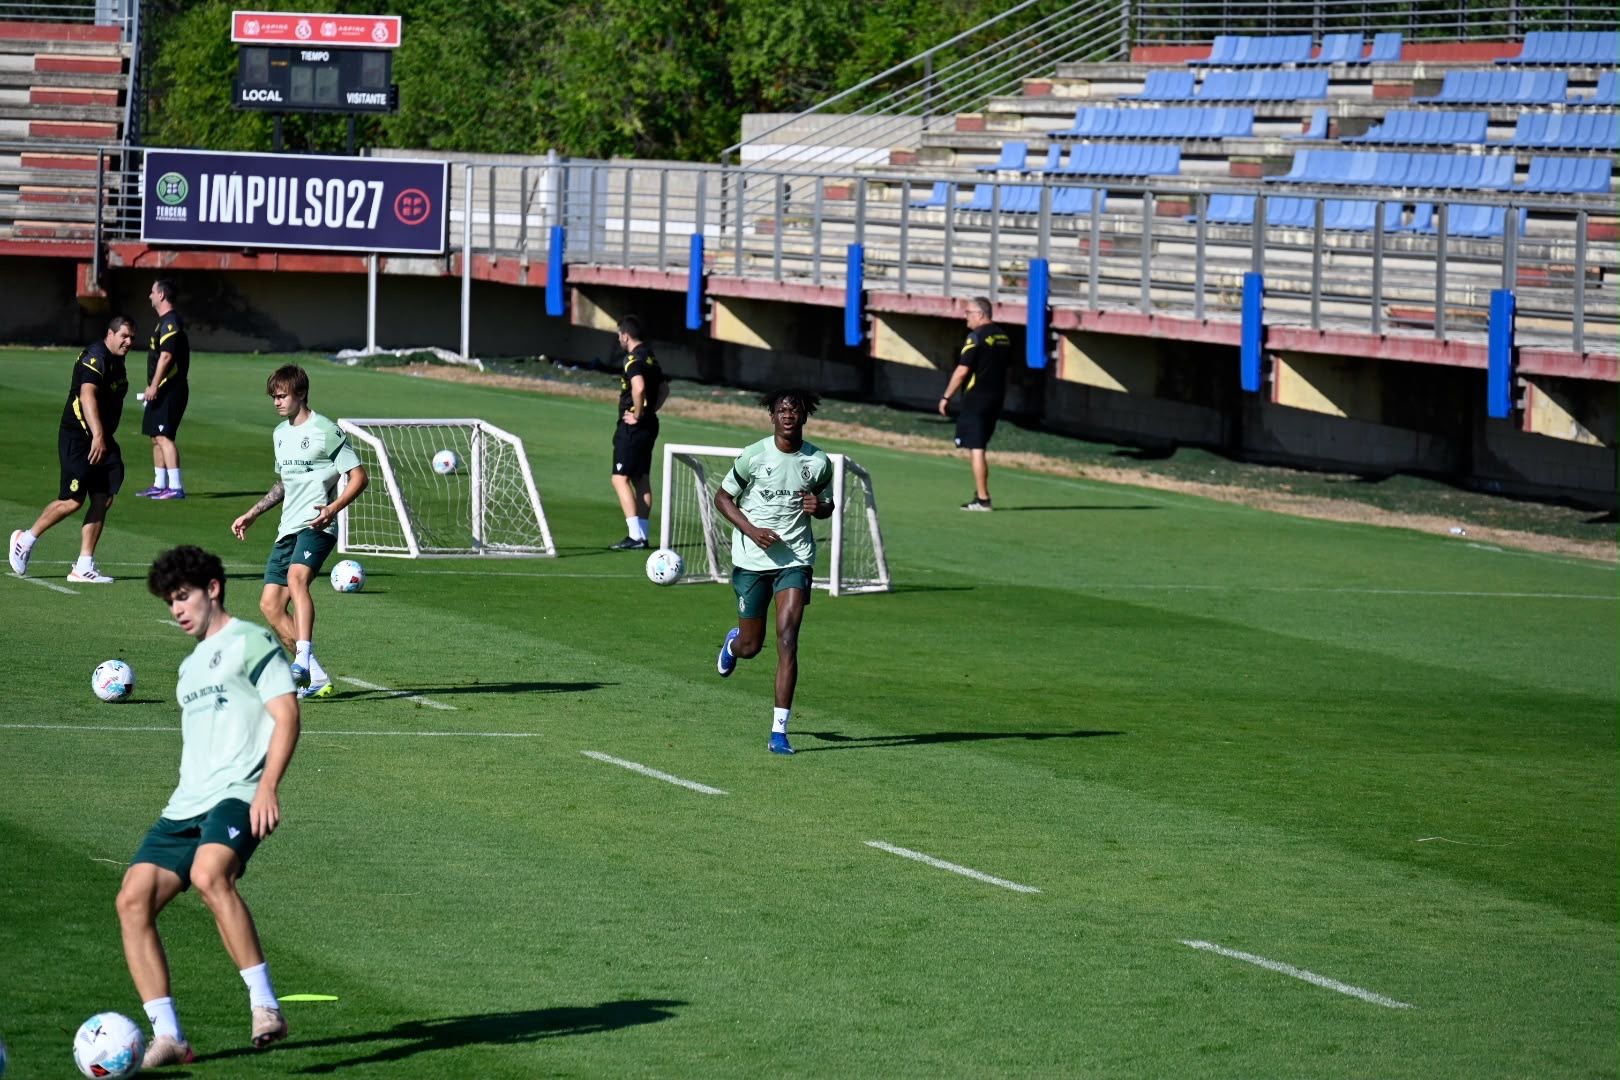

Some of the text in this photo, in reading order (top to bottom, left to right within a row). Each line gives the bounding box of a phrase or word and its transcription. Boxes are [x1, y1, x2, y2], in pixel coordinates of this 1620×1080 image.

[301, 51, 329, 61] TIEMPO
[242, 89, 283, 102] LOCAL
[346, 92, 386, 105] VISITANTE
